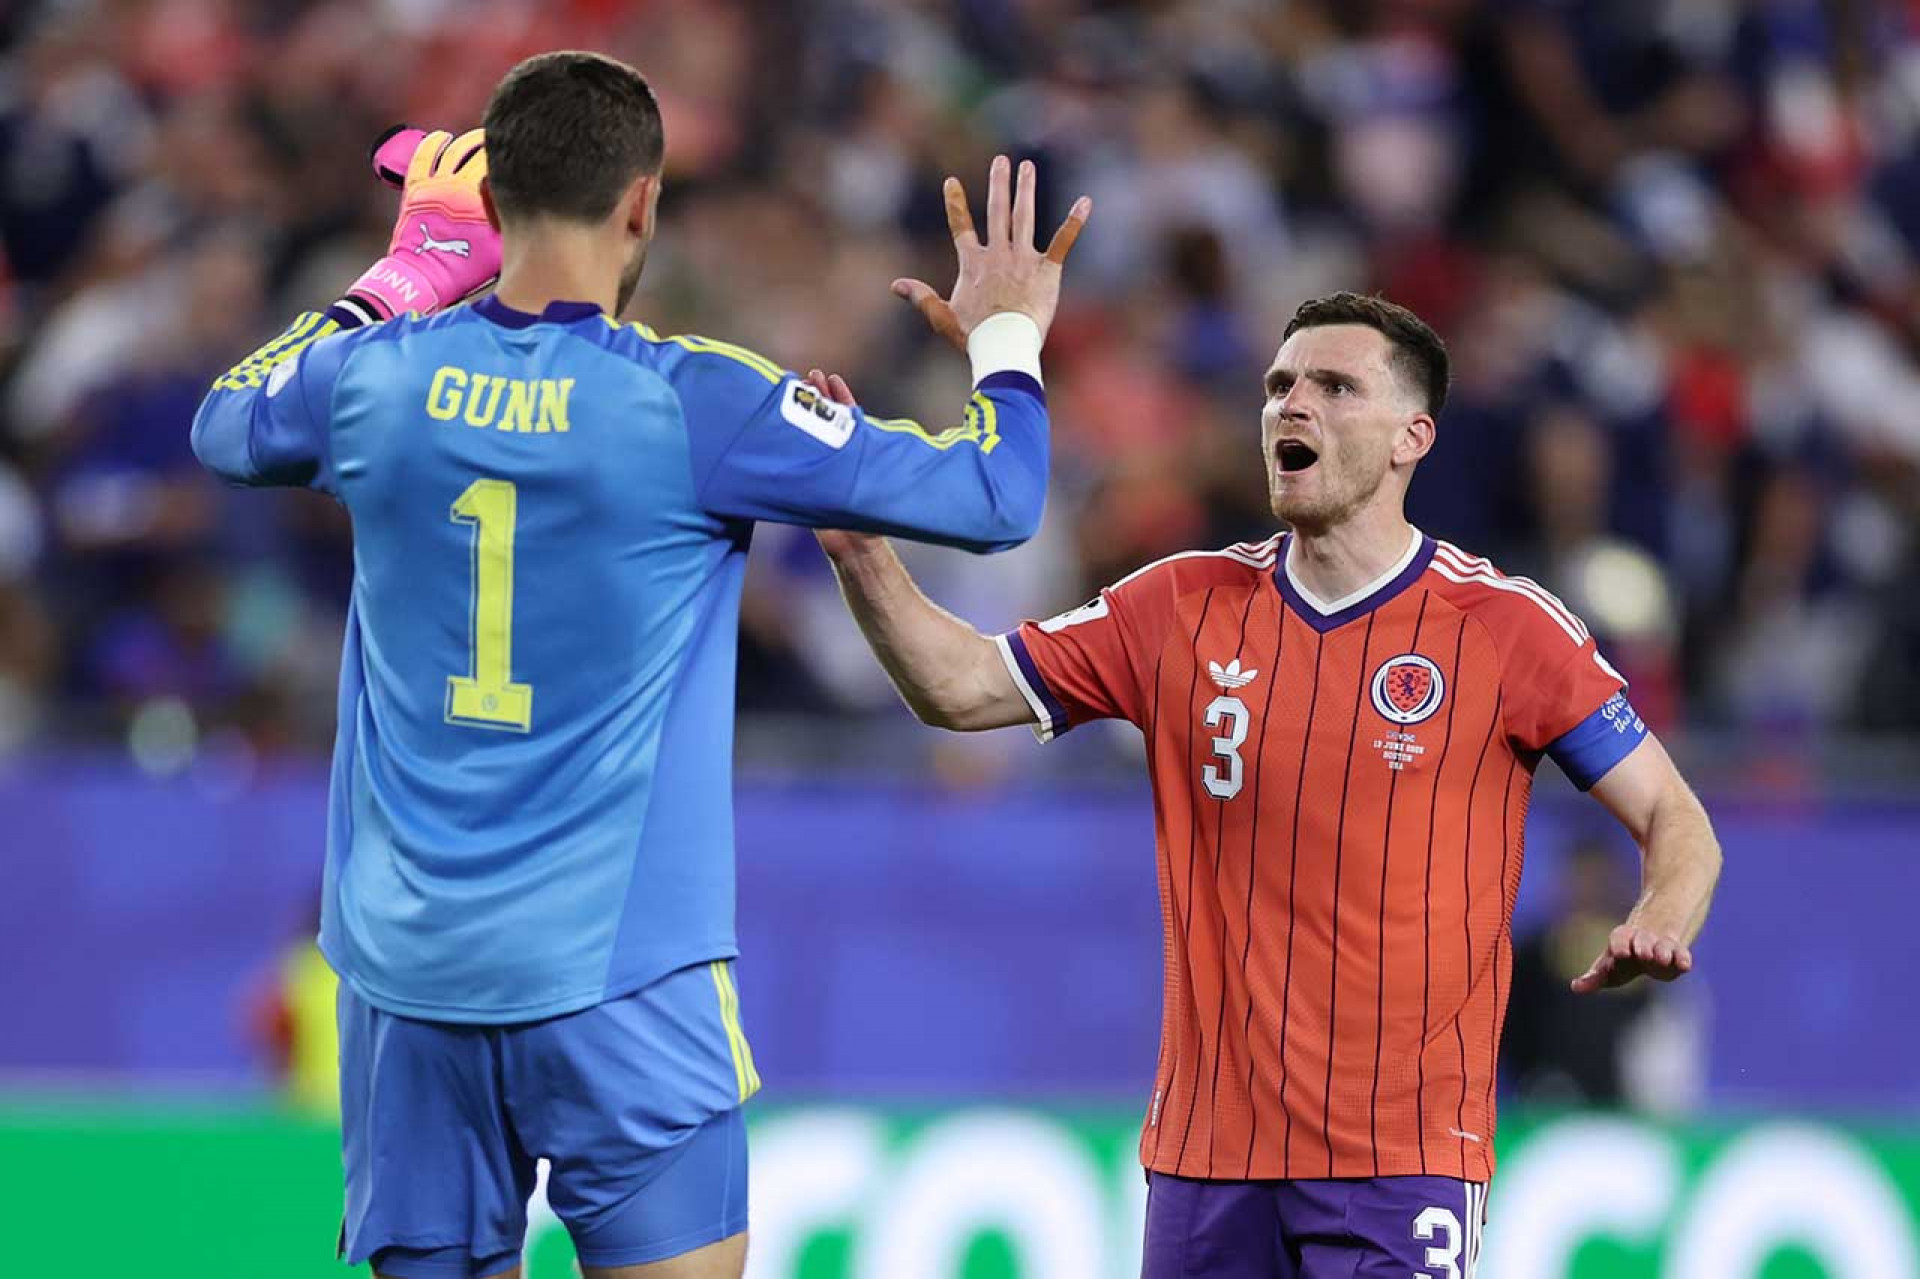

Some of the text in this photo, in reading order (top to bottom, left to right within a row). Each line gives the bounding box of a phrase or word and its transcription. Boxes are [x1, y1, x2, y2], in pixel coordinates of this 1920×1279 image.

[425, 365, 577, 433] GUNN
[444, 478, 532, 734] 1
[1203, 696, 1249, 800] 3
[1413, 1207, 1461, 1279] 3
